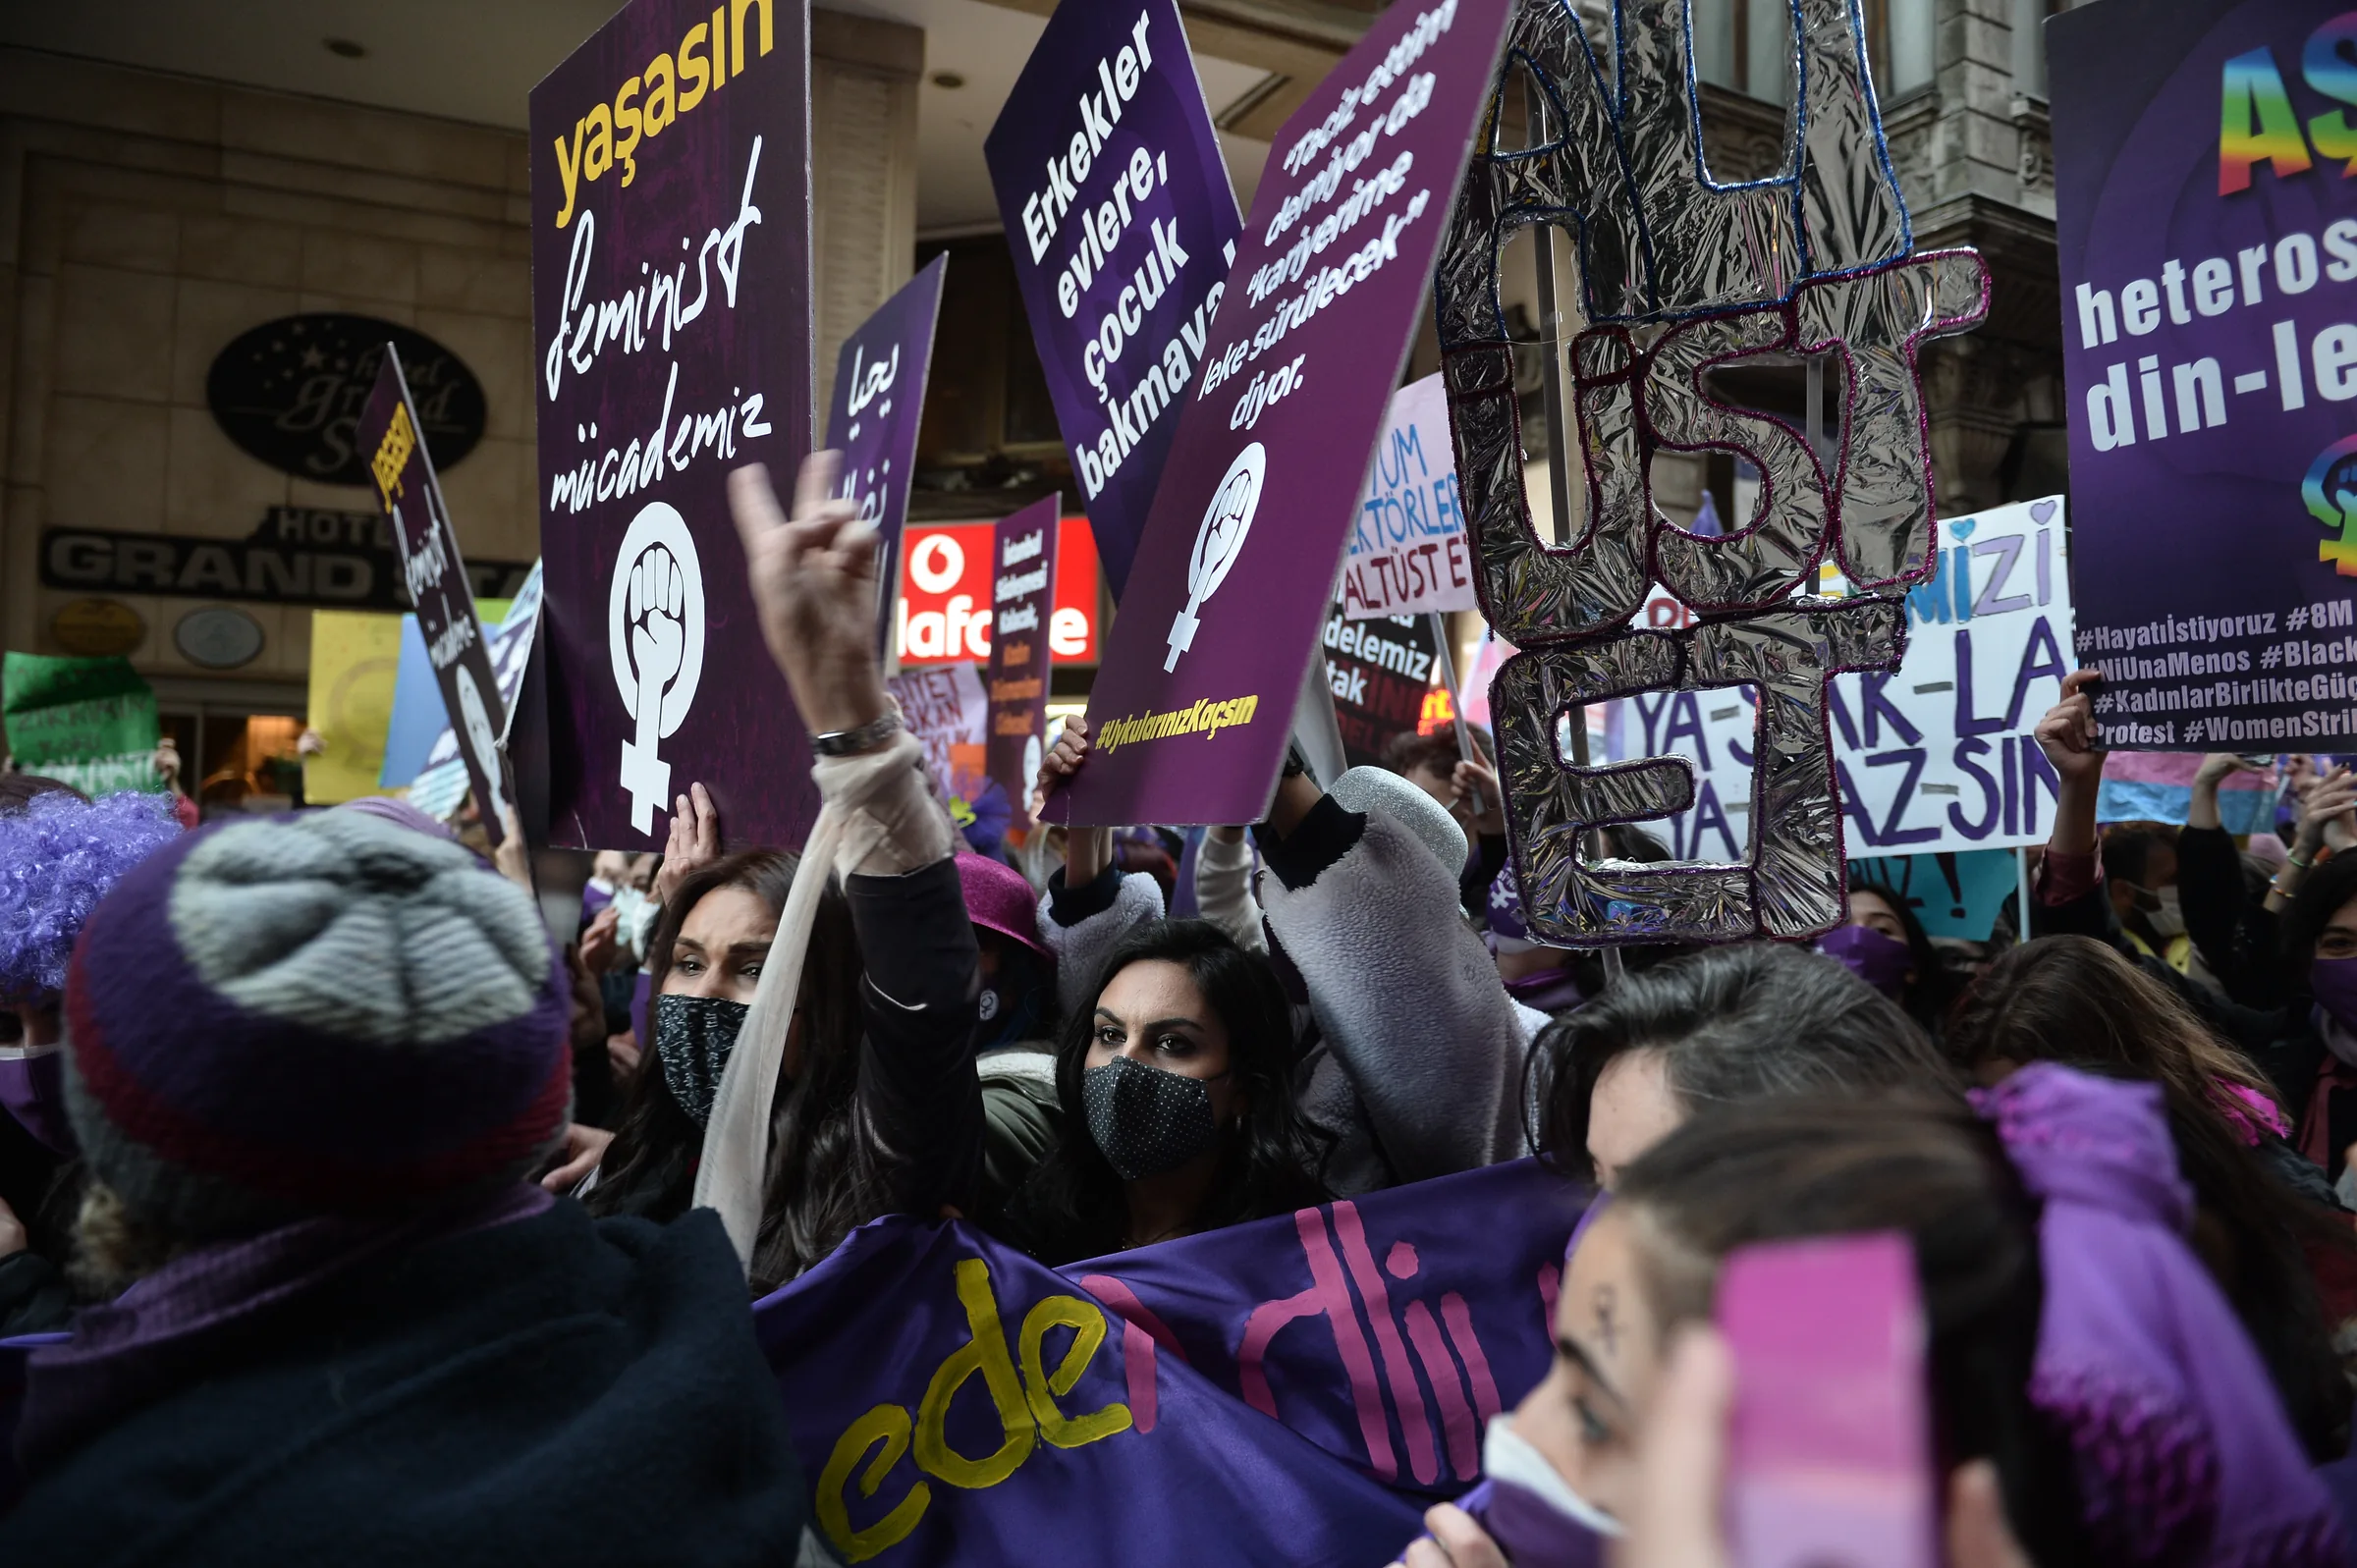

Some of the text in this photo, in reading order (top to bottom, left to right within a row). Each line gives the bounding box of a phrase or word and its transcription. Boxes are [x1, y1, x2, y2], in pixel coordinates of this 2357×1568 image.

[555, 0, 774, 229] yaşasın
[1021, 8, 1152, 266] Erkekler
[546, 135, 762, 402] feminist
[1058, 146, 1168, 319] evlere,
[2075, 218, 2357, 350] heteros
[1084, 216, 1190, 404] çocuk
[1197, 339, 1250, 402] leke
[550, 360, 772, 514] mücademiz
[1230, 353, 1306, 431] diyor.
[2086, 319, 2357, 453] din-le
[47, 533, 376, 600] GRAND
[1343, 543, 1439, 614] ALTÜST
[2285, 599, 2354, 631] #8M
[1323, 614, 1432, 683] delemiz
[1327, 659, 1368, 706] tak
